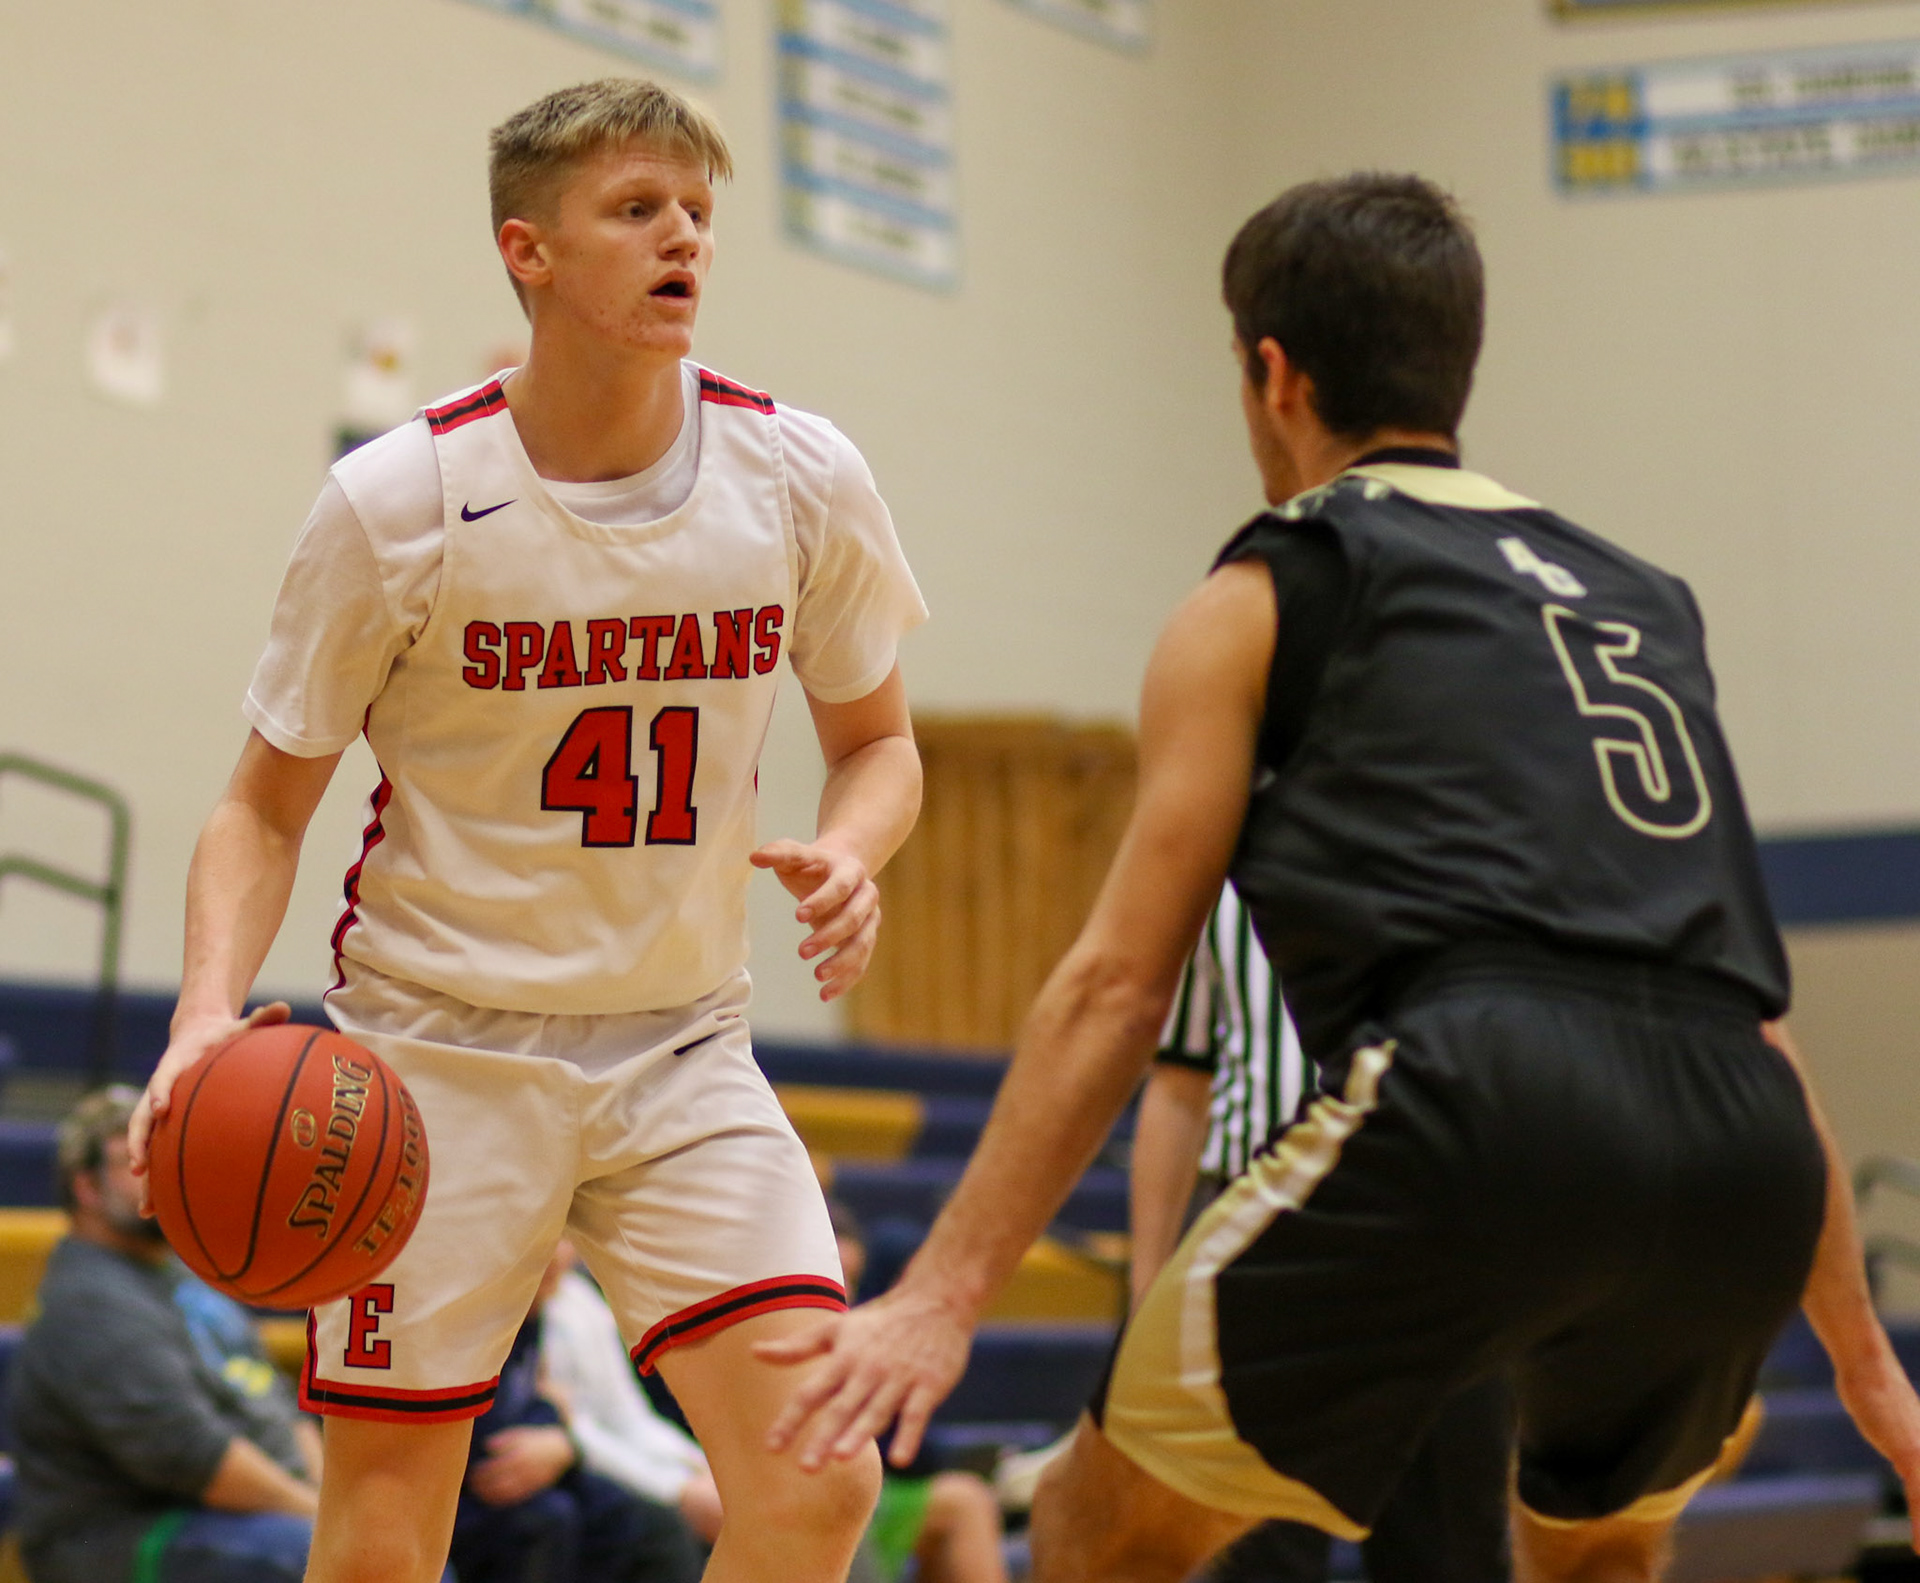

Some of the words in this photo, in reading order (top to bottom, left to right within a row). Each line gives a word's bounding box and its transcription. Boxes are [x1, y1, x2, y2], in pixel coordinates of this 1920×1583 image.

[462, 604, 784, 691] SPARTANS
[540, 705, 699, 848] 41
[1542, 604, 1712, 839] 5
[289, 1055, 374, 1240] SPALDING
[344, 1283, 395, 1370] E
